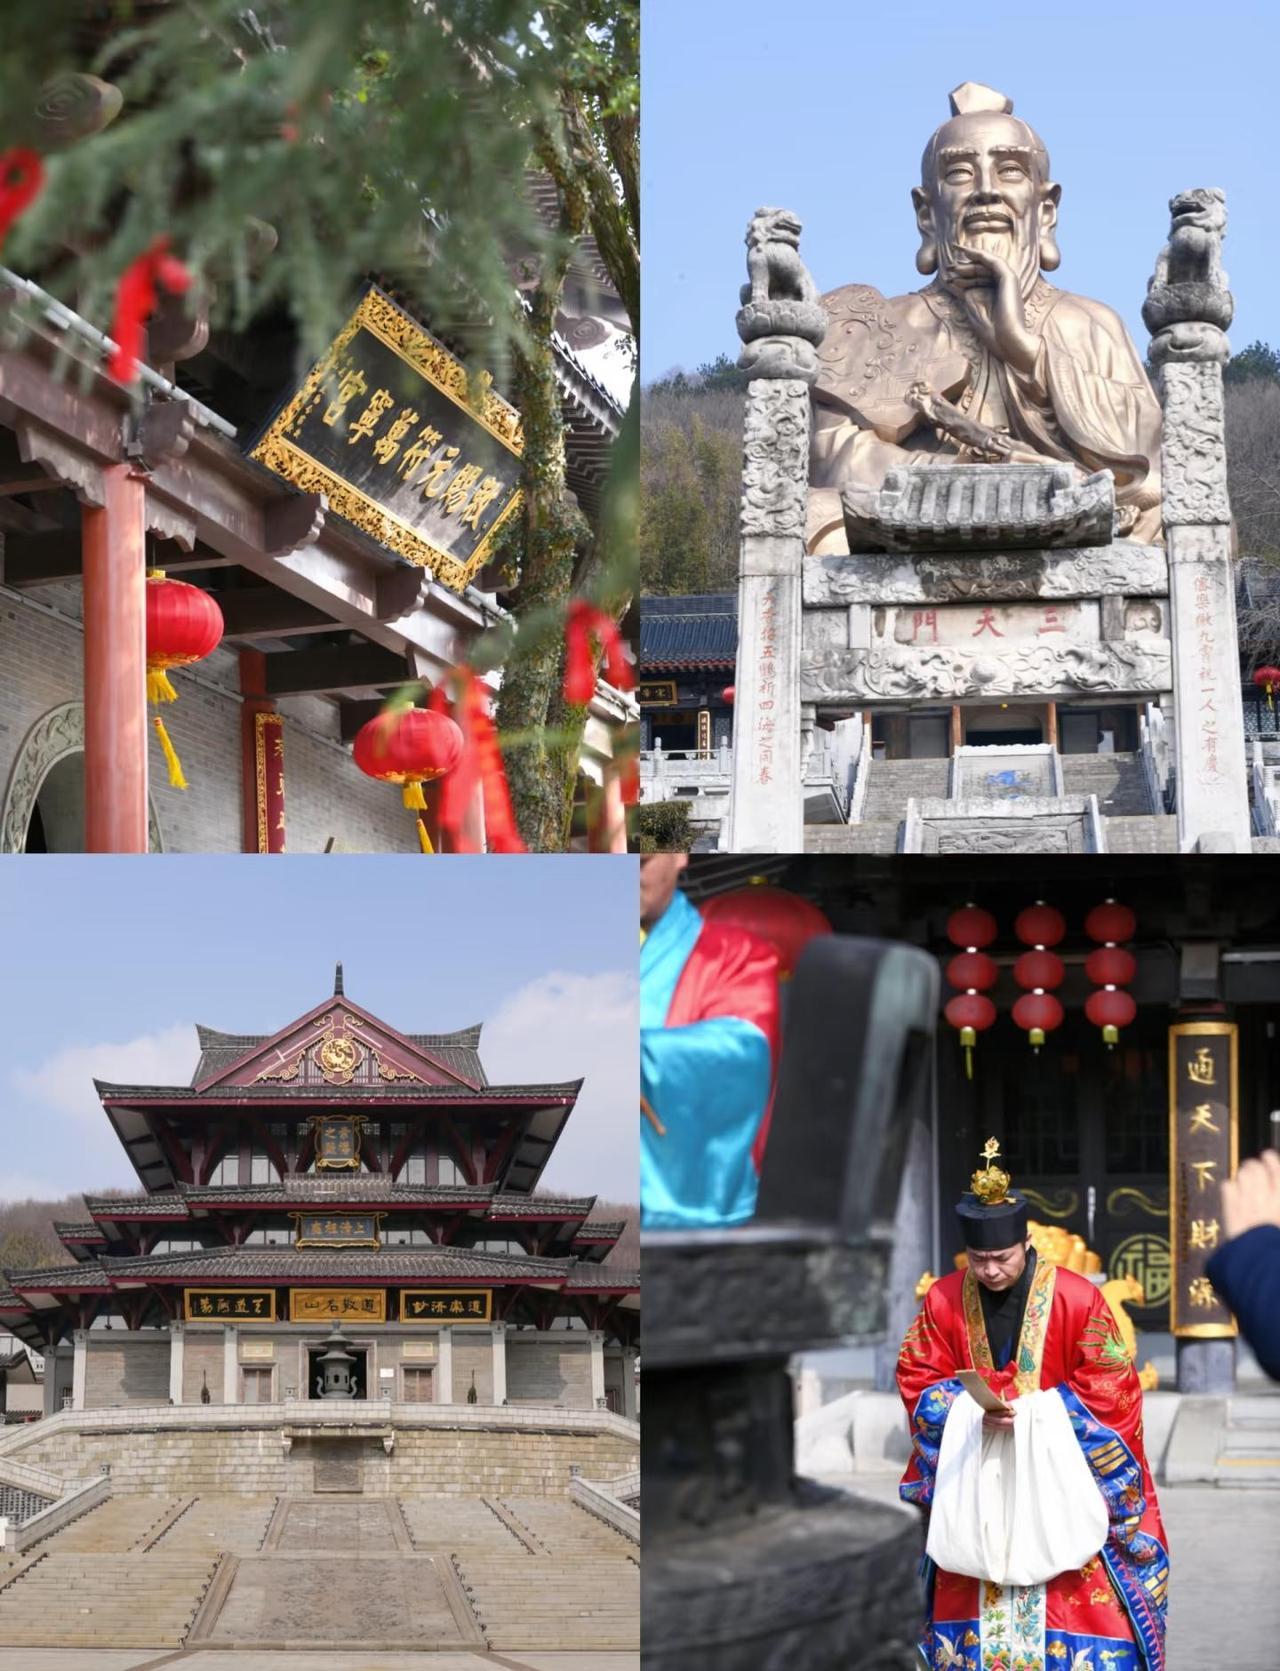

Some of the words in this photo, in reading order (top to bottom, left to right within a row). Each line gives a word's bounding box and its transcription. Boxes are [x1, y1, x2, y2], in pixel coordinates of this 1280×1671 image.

[912, 607, 1067, 642] 三天門
[1187, 1048, 1220, 1311] 通天下財源
